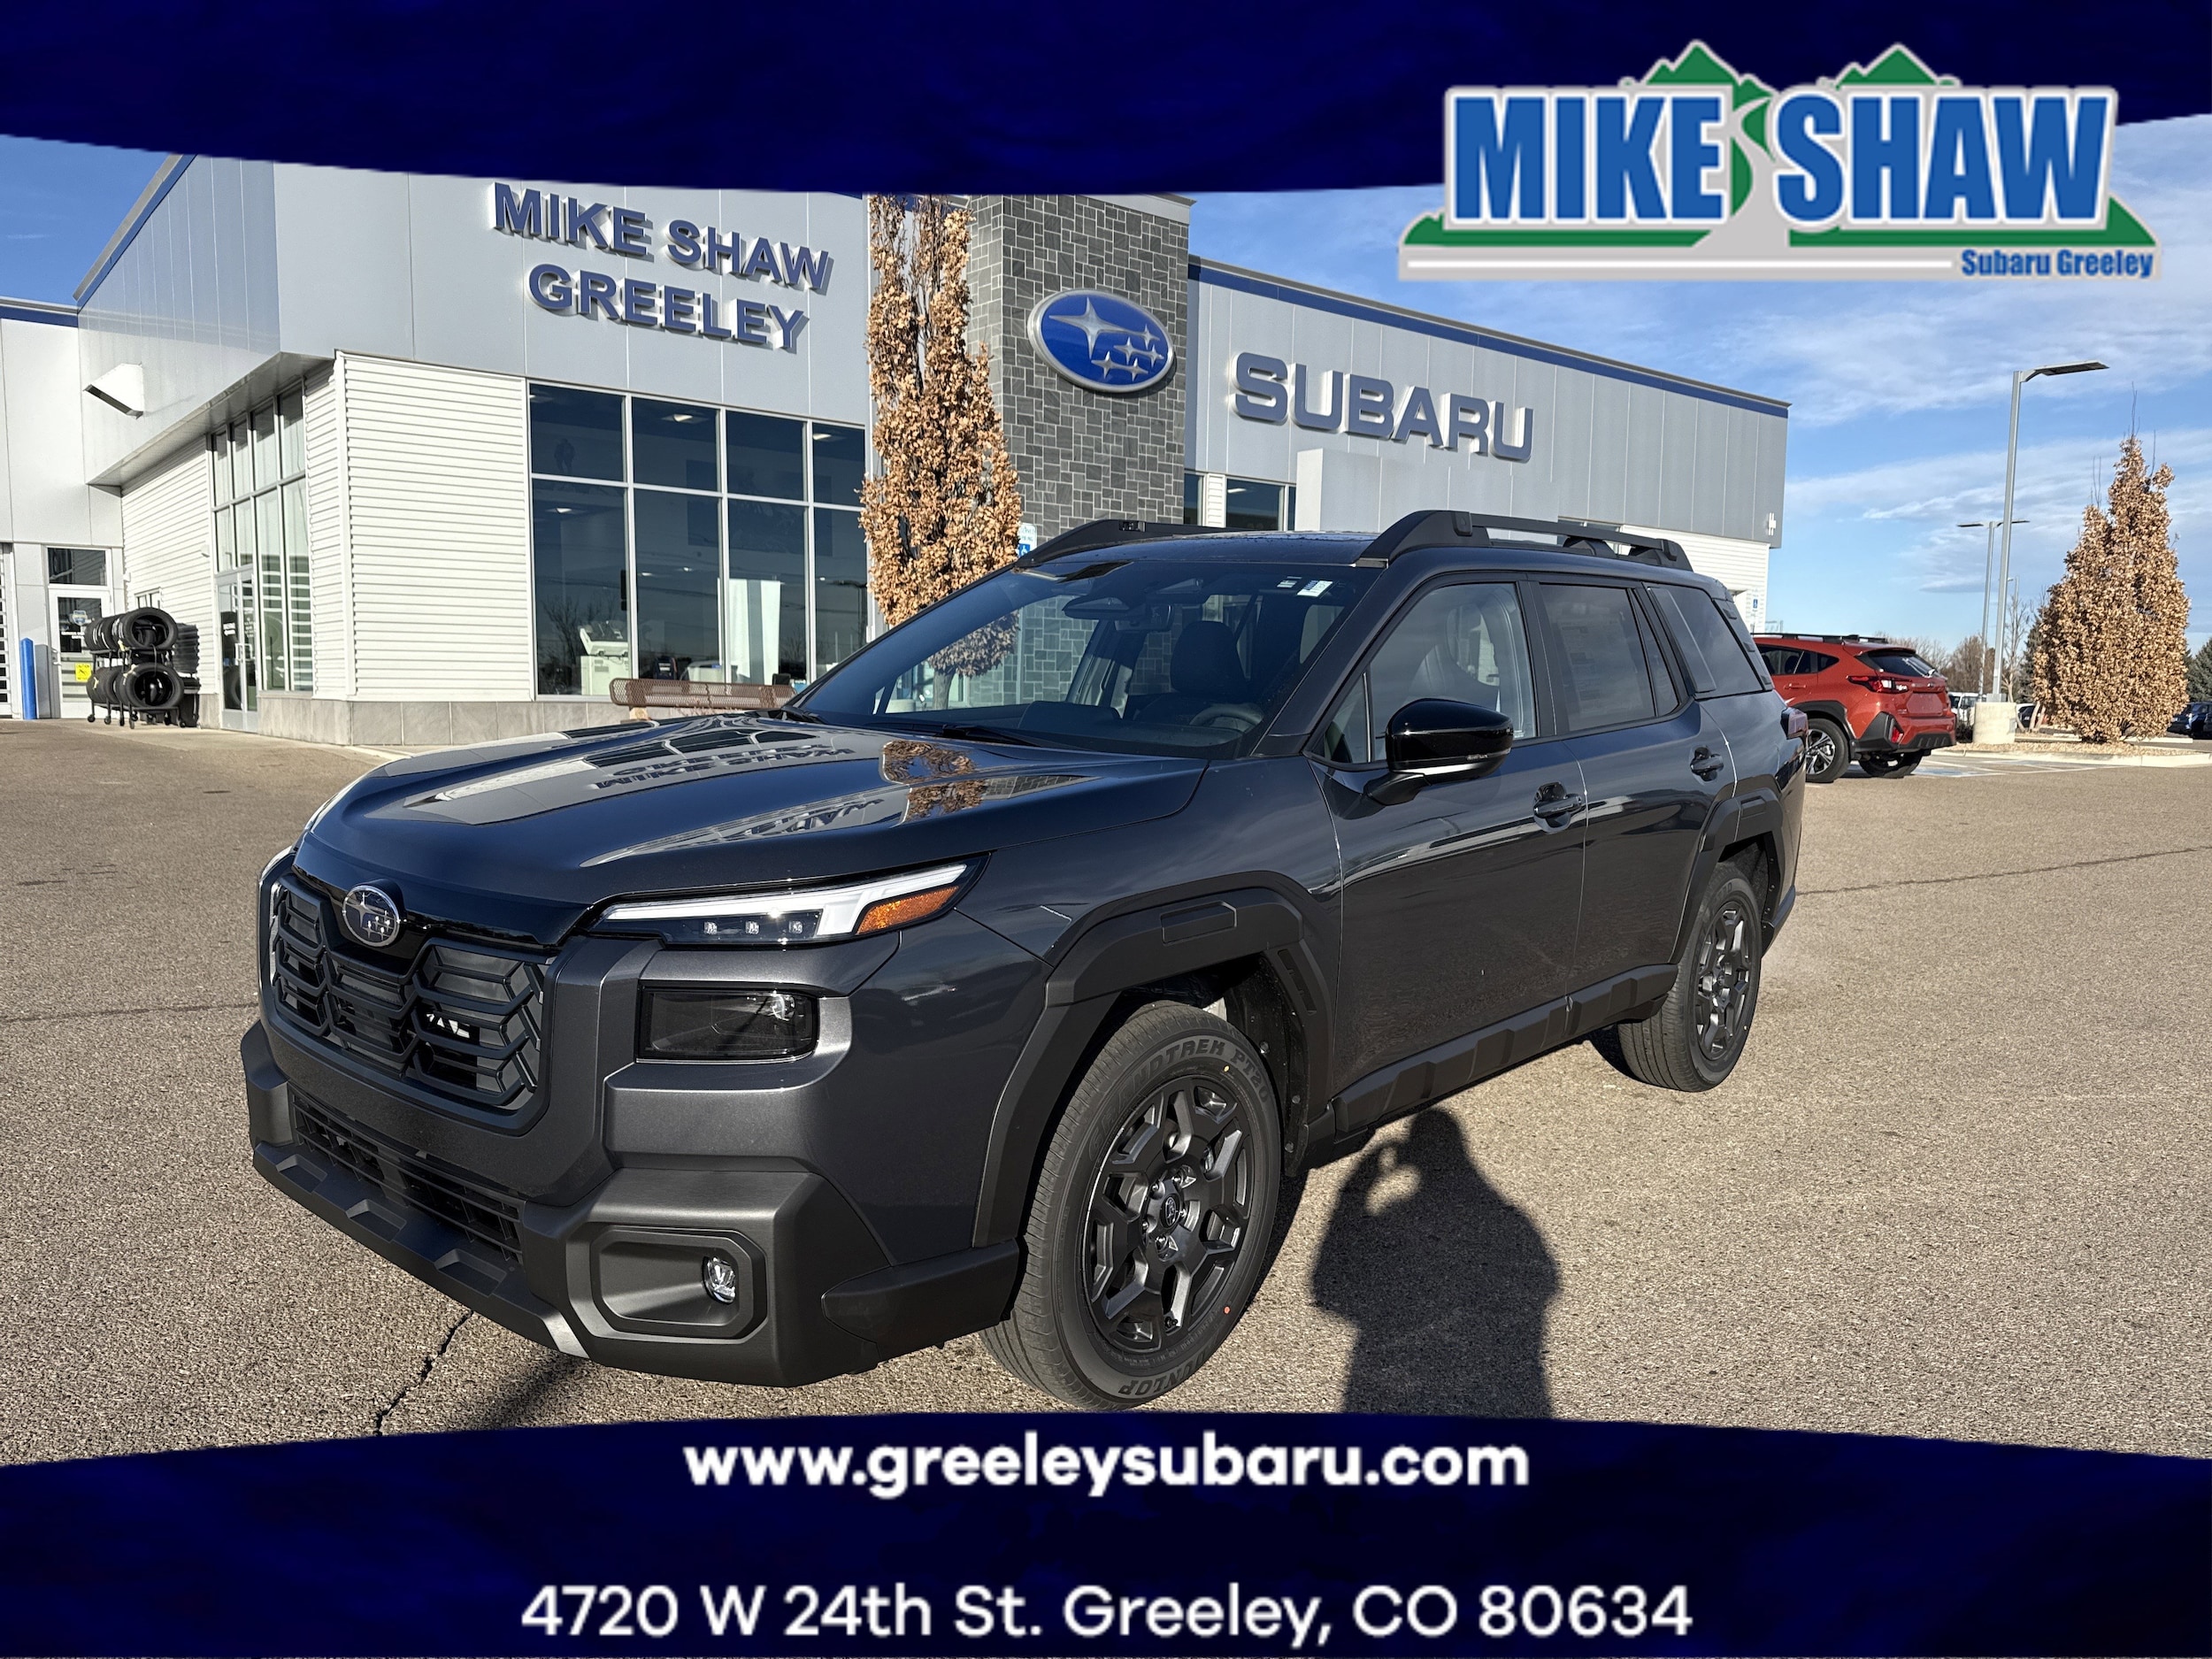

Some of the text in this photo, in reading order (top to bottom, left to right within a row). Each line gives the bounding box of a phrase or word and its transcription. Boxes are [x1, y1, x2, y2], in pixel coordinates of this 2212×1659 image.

[493, 181, 829, 290] MIKE SHAW
[528, 263, 804, 349] GREELEY
[1230, 351, 1534, 463] SUBARU
